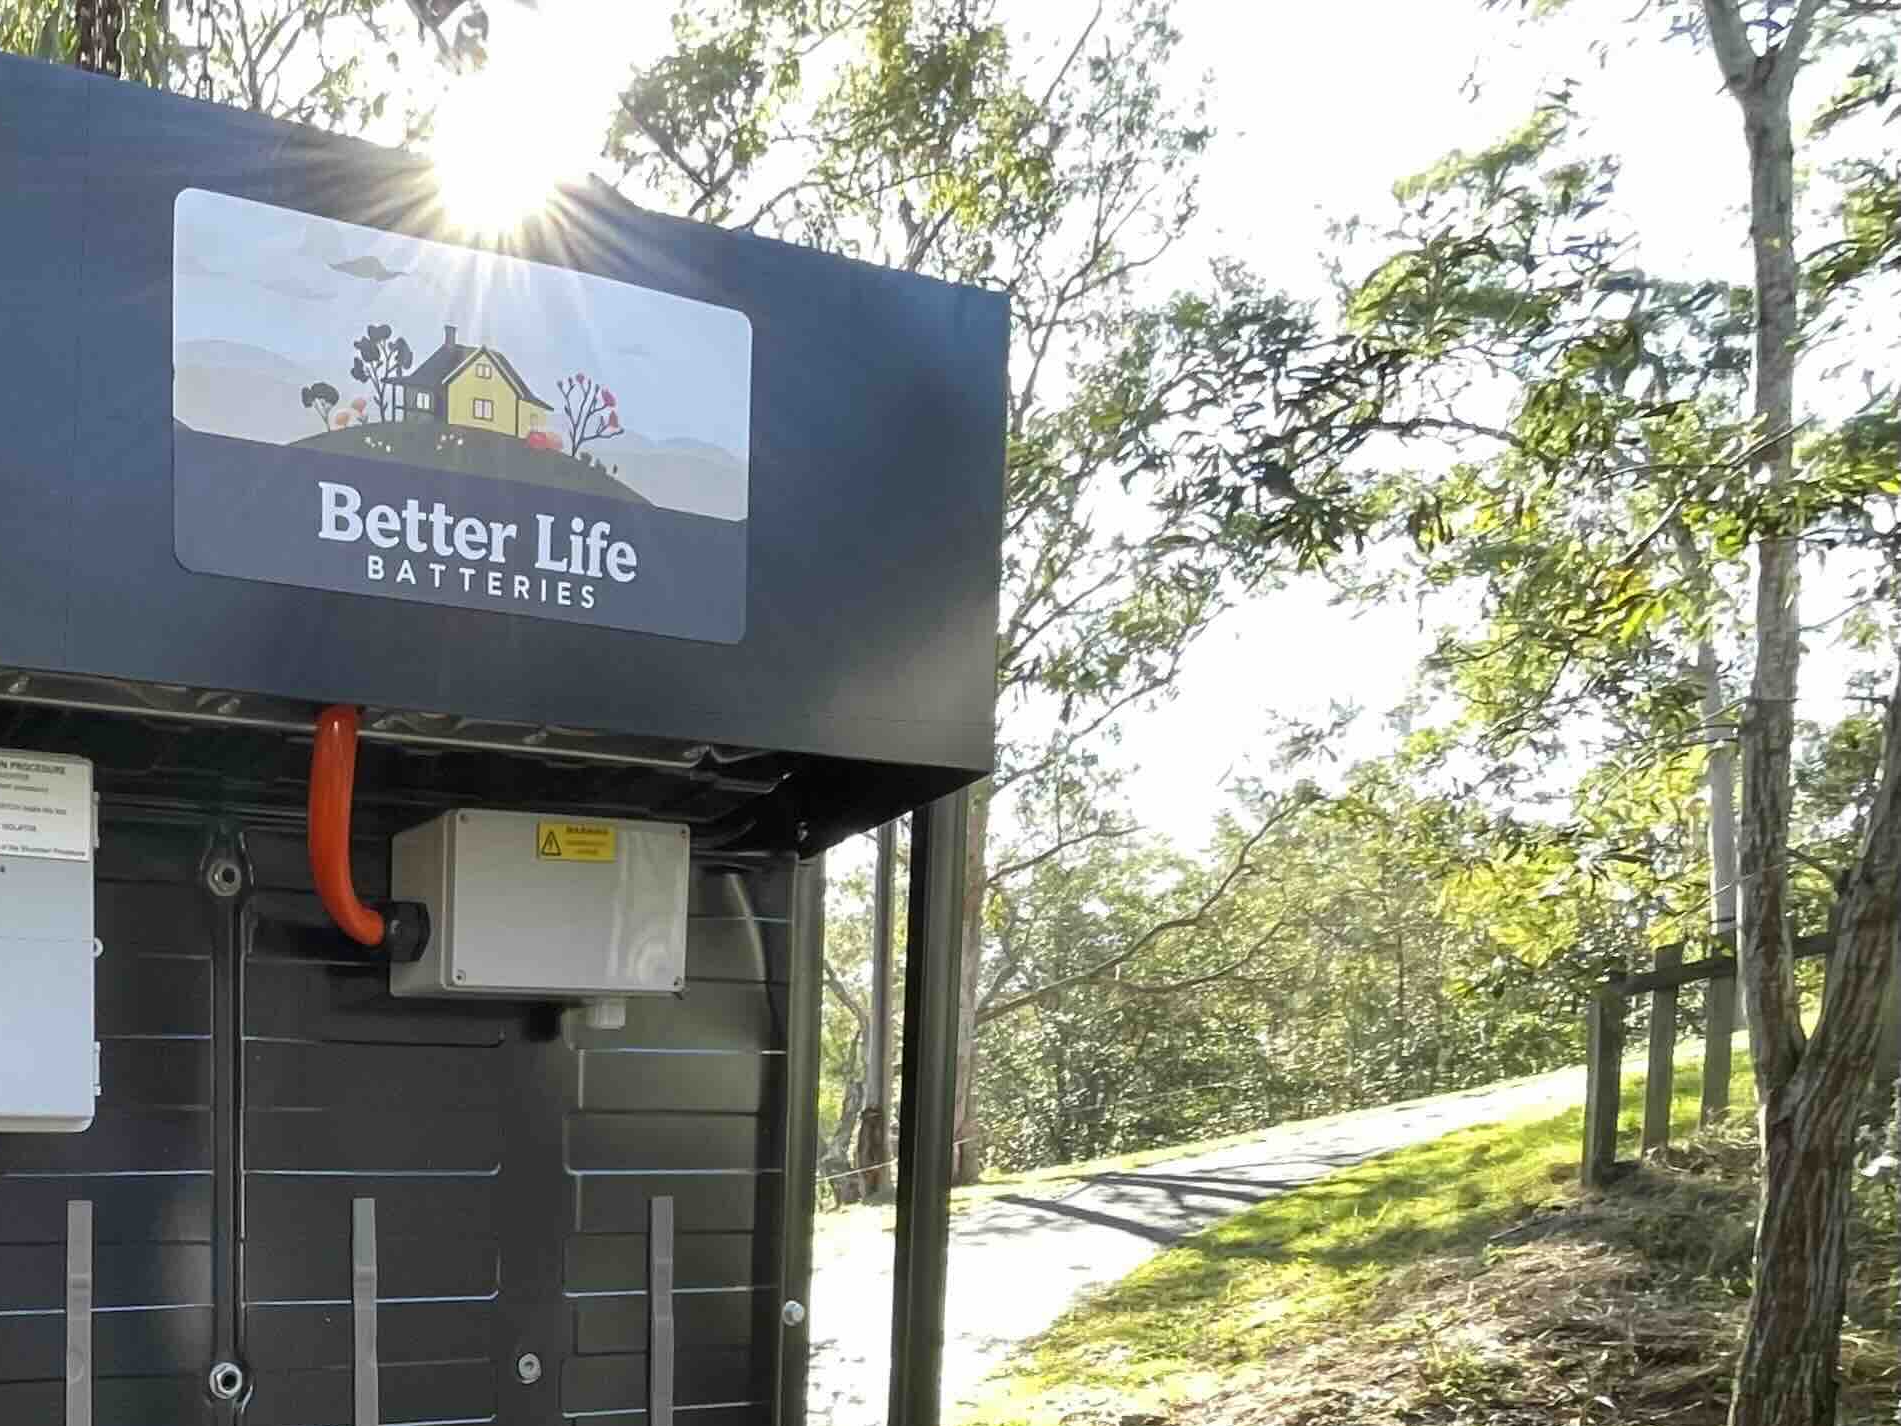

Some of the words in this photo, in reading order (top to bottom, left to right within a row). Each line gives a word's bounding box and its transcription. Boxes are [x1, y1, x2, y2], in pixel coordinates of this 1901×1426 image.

[318, 480, 517, 563] Better
[535, 513, 637, 583] Life
[367, 555, 595, 609] BATTERIES
[10, 761, 66, 775] PROCEDURE
